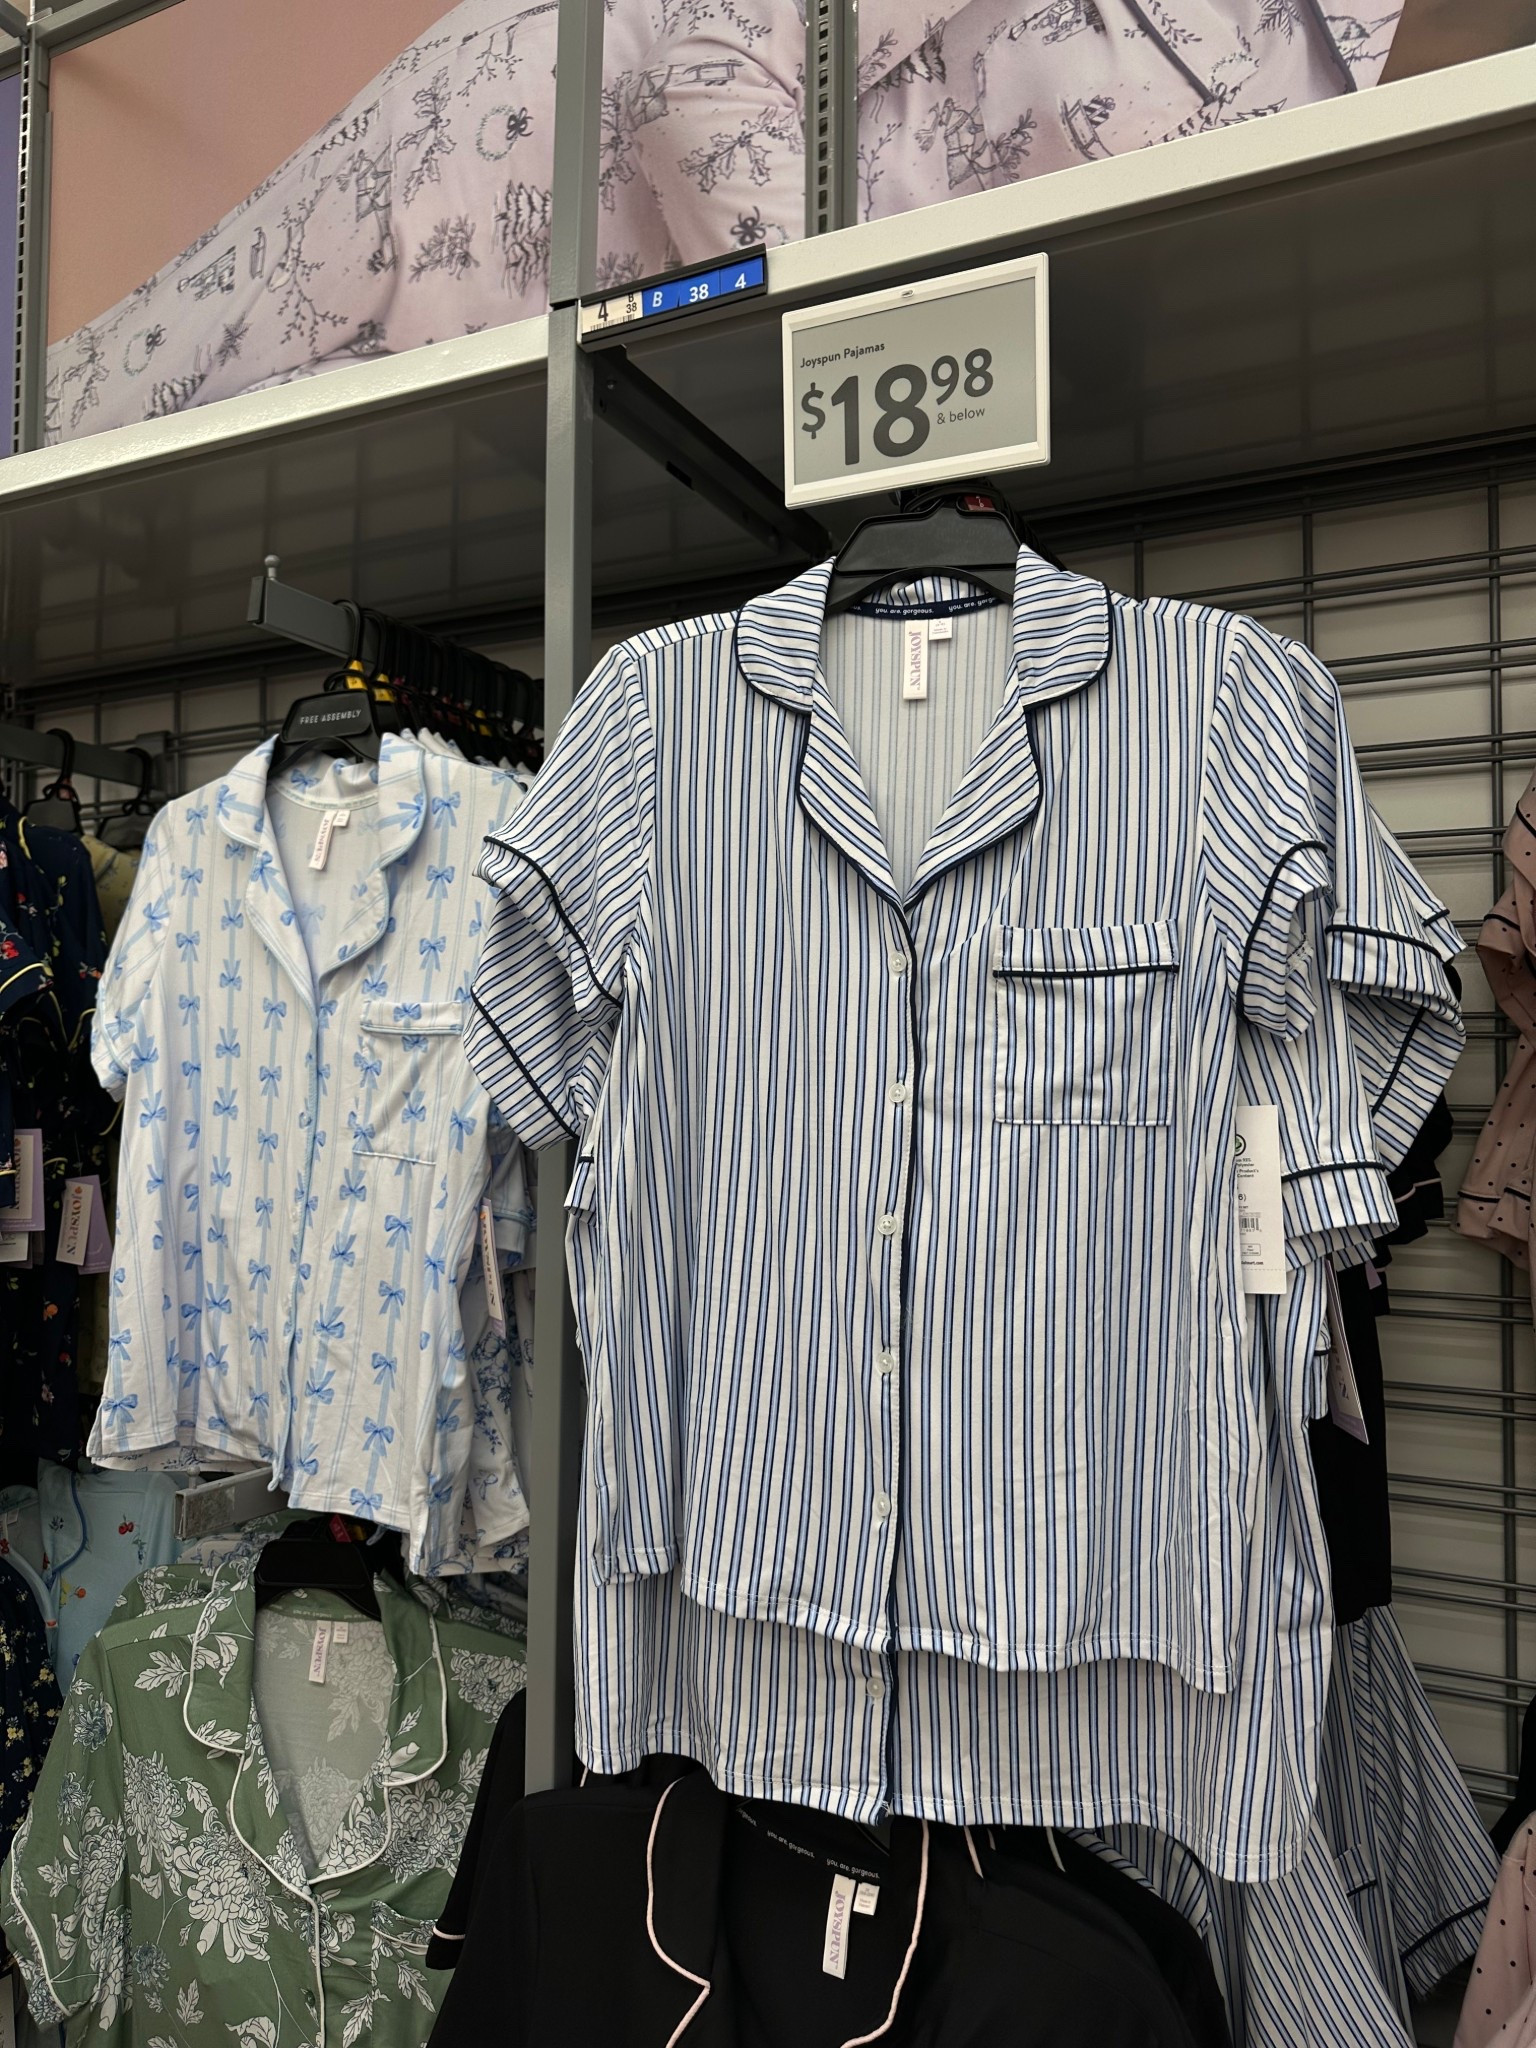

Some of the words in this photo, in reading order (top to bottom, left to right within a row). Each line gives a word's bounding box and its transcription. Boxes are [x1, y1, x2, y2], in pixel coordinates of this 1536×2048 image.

[652, 291, 663, 308] B
[689, 283, 709, 303] 38
[734, 273, 746, 290] 4
[598, 302, 608, 322] 4
[626, 302, 638, 314] 38
[800, 354, 841, 368] Joyspun
[843, 343, 885, 359] Pajamas
[937, 412, 946, 425] &
[949, 407, 985, 423] below
[910, 631, 922, 687] JOYSPUN
[300, 715, 319, 725] FREE
[321, 709, 362, 723] ASSEMBLY
[313, 1627, 327, 1673] JOYSPUN
[829, 1890, 846, 1966] JOYSPUN
